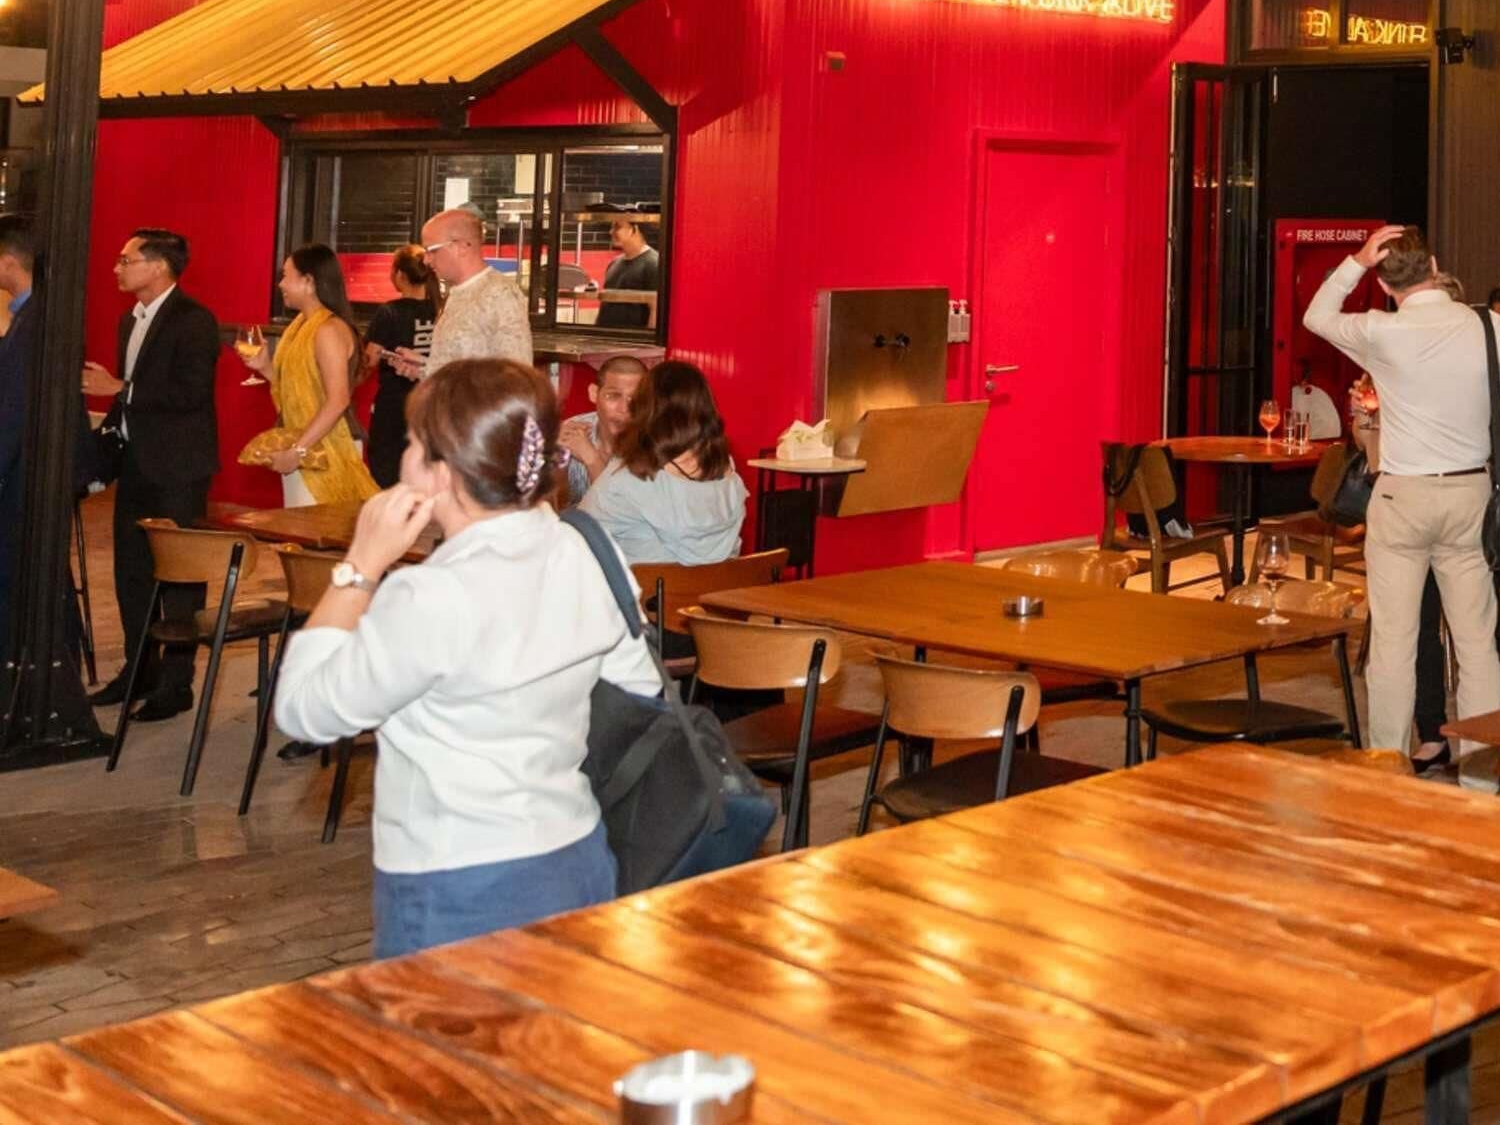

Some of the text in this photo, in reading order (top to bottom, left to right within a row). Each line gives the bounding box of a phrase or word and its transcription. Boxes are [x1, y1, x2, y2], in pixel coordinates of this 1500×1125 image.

[1296, 229, 1368, 241] FIRE HOSE CABINET
